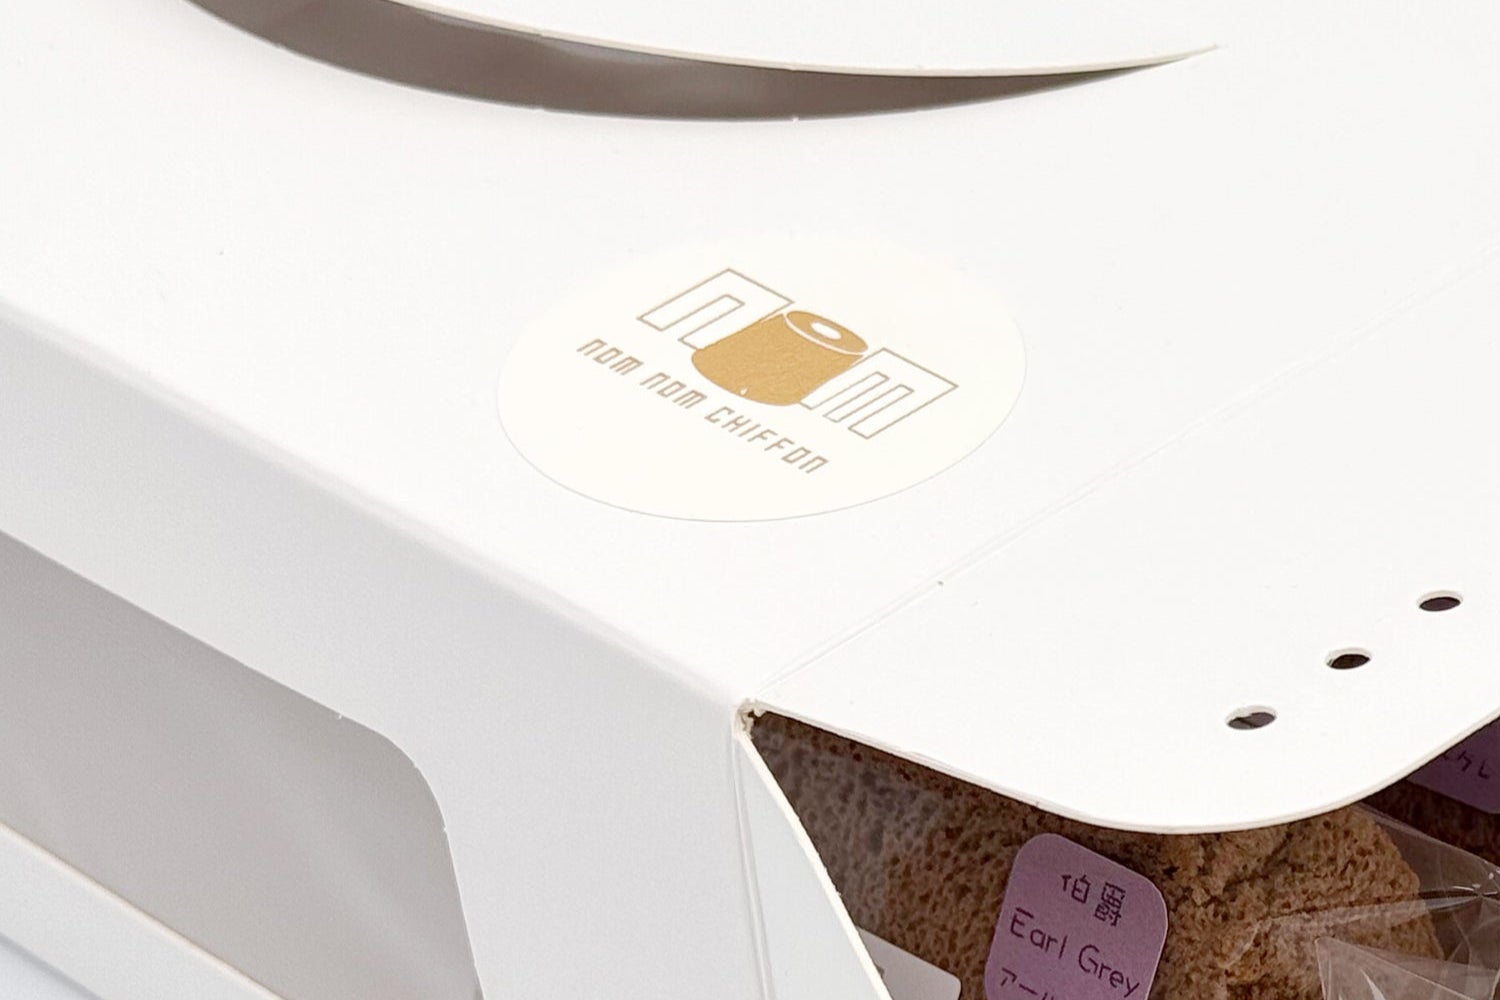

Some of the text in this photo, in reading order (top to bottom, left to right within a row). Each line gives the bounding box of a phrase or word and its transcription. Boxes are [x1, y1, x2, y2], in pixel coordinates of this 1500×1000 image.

[1061, 874, 1126, 927] 伯爵
[1009, 906, 1140, 998] Earl Grey
